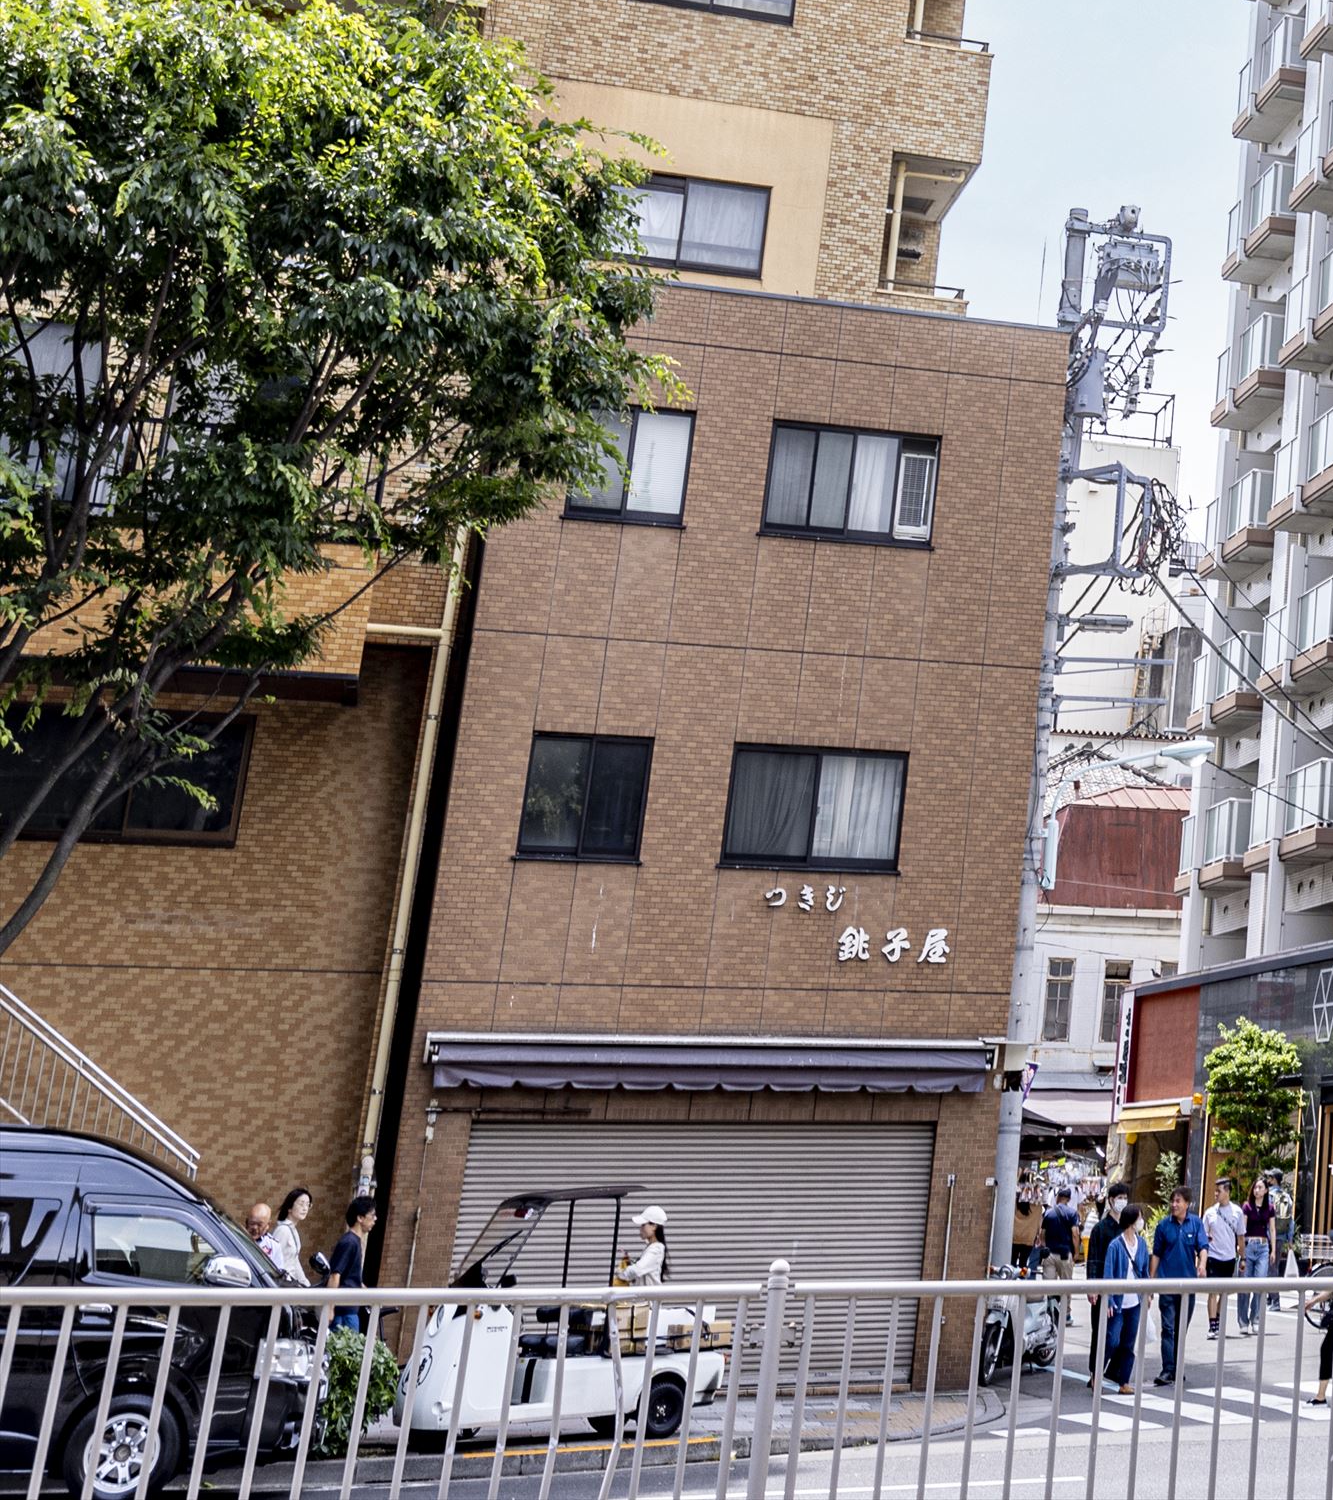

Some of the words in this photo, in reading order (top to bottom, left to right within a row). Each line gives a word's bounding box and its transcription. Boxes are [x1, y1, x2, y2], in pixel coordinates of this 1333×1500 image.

[764, 883, 847, 912] つきじ
[838, 925, 950, 963] 銚子屋
